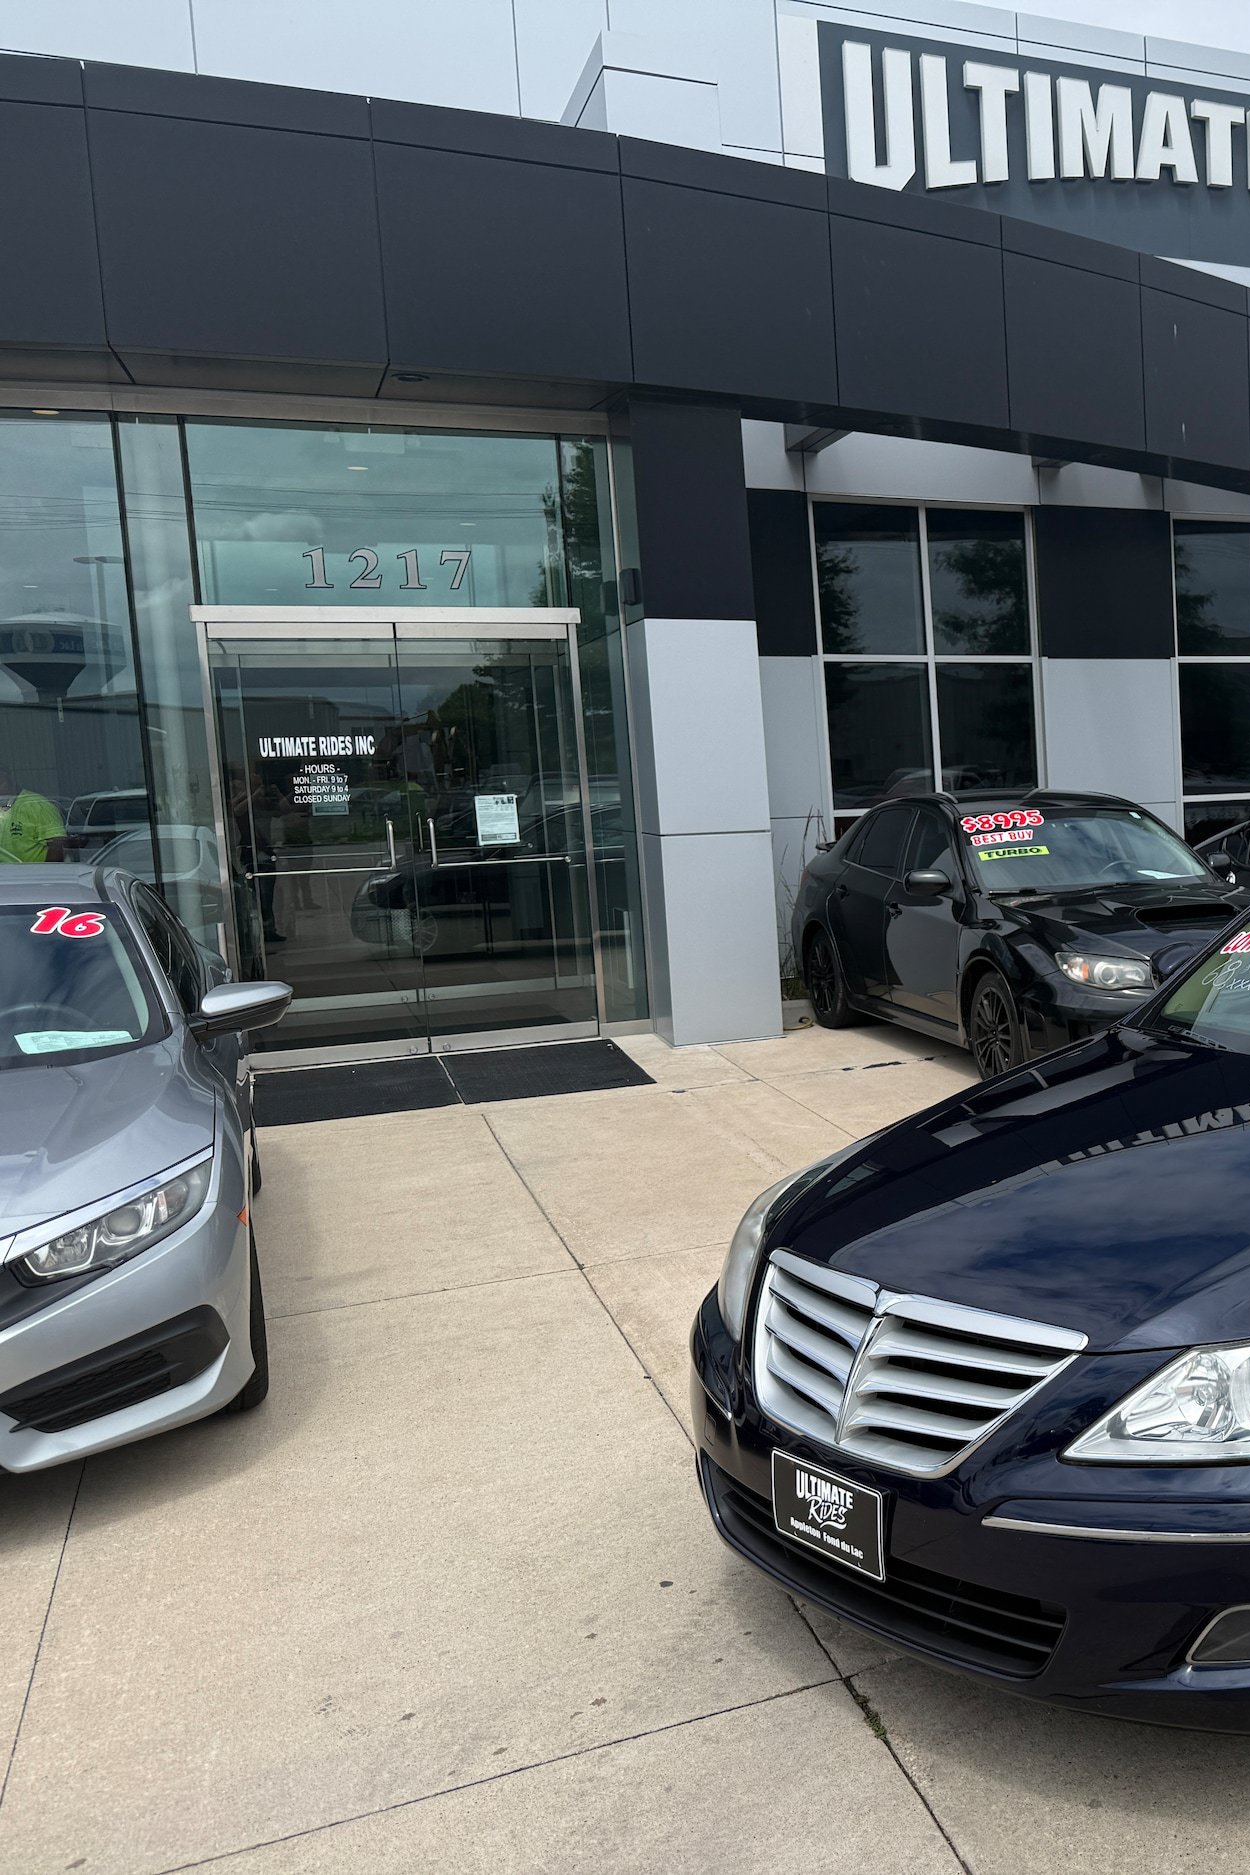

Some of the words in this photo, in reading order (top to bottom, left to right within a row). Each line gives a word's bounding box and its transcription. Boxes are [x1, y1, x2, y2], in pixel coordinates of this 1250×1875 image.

[302, 547, 472, 590] 1217
[259, 737, 317, 758] ULTIMATE
[319, 736, 353, 757] RIDES
[355, 735, 375, 756] INC
[304, 764, 335, 774] HOURS
[293, 776, 311, 785] MON.
[331, 775, 336, 784] 9
[344, 775, 348, 783] 7
[294, 785, 331, 794] SATURDAY
[332, 785, 336, 793] 9
[344, 784, 349, 793] 4
[293, 795, 322, 804] CLOSED
[323, 794, 351, 803] SUNDAY
[961, 809, 1044, 833] $8995
[970, 832, 1004, 846] BEST
[1007, 829, 1033, 842] BUY
[984, 847, 1041, 858] TURBO
[30, 906, 106, 938] 16
[796, 1469, 853, 1509] ULTIMATE
[790, 1516, 821, 1539] Appleton
[823, 1532, 840, 1548] Fond
[851, 1545, 863, 1559] Lac
